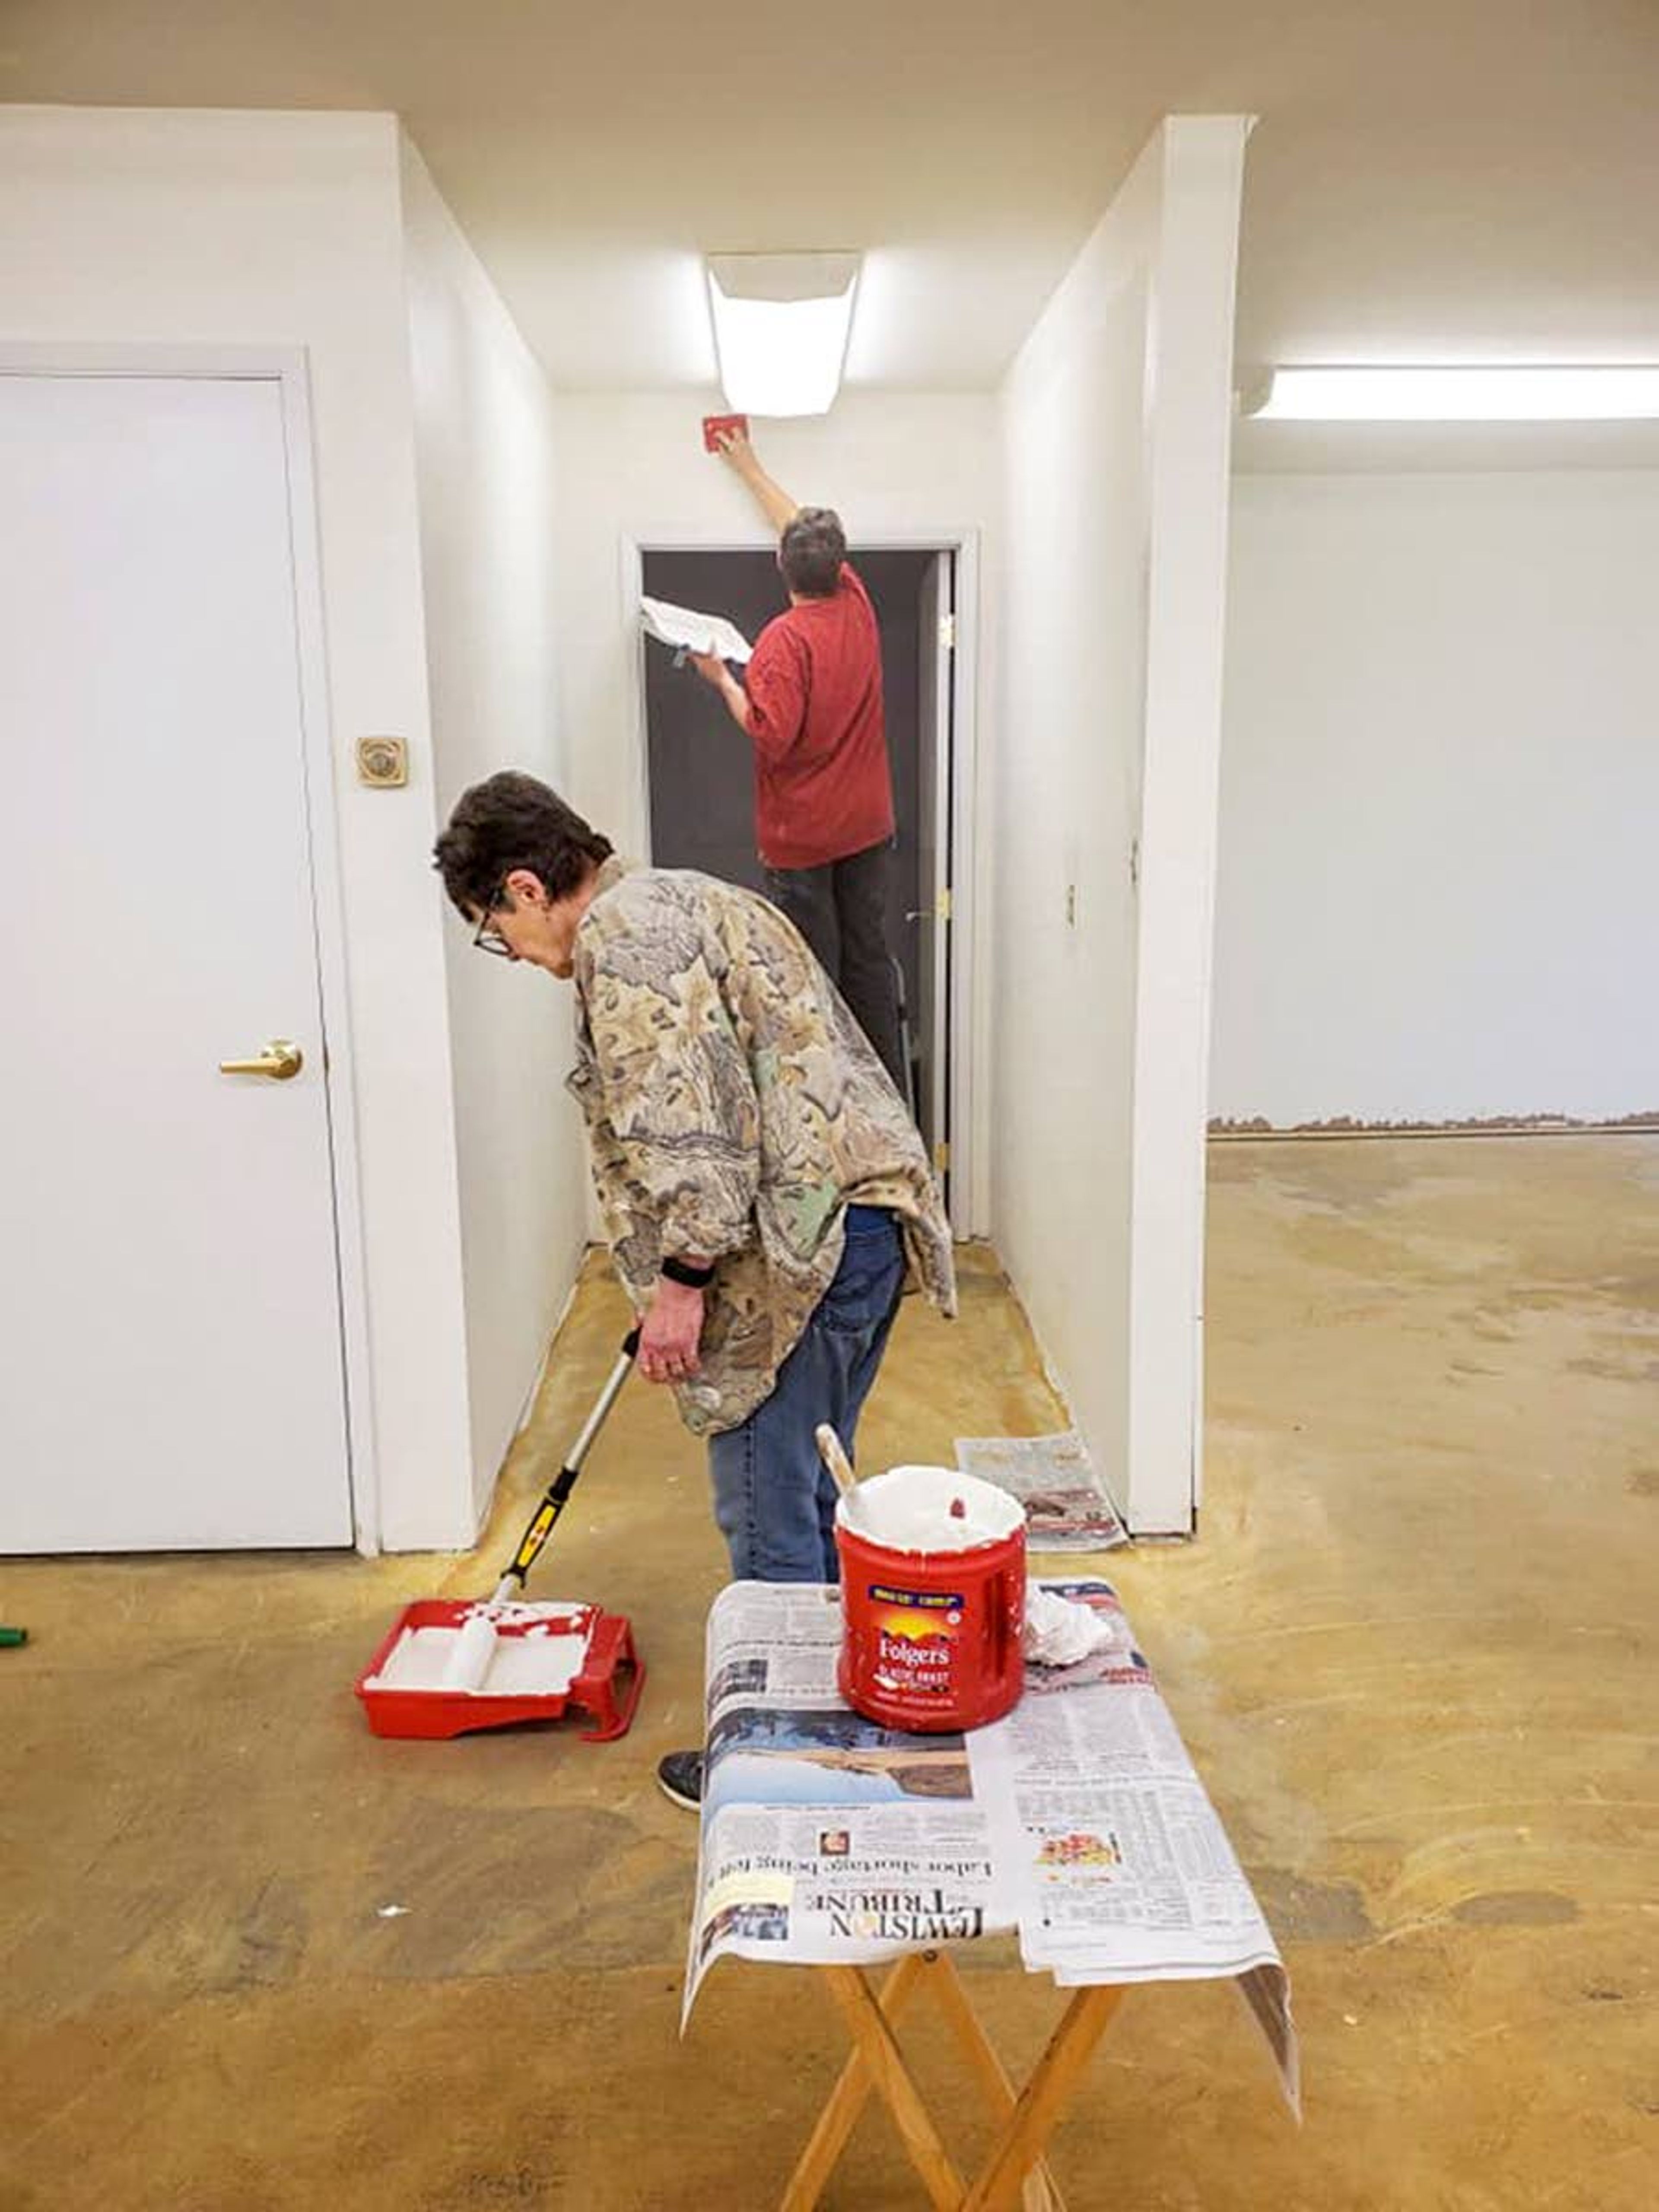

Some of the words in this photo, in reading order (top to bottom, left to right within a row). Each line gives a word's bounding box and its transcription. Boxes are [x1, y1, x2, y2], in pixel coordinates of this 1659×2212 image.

[880, 1639, 950, 1667] Folgers
[756, 1856, 817, 1875] being
[824, 1858, 919, 1875] shortage
[928, 1861, 991, 1877] Labor
[806, 1889, 955, 1915] TRIBUNE
